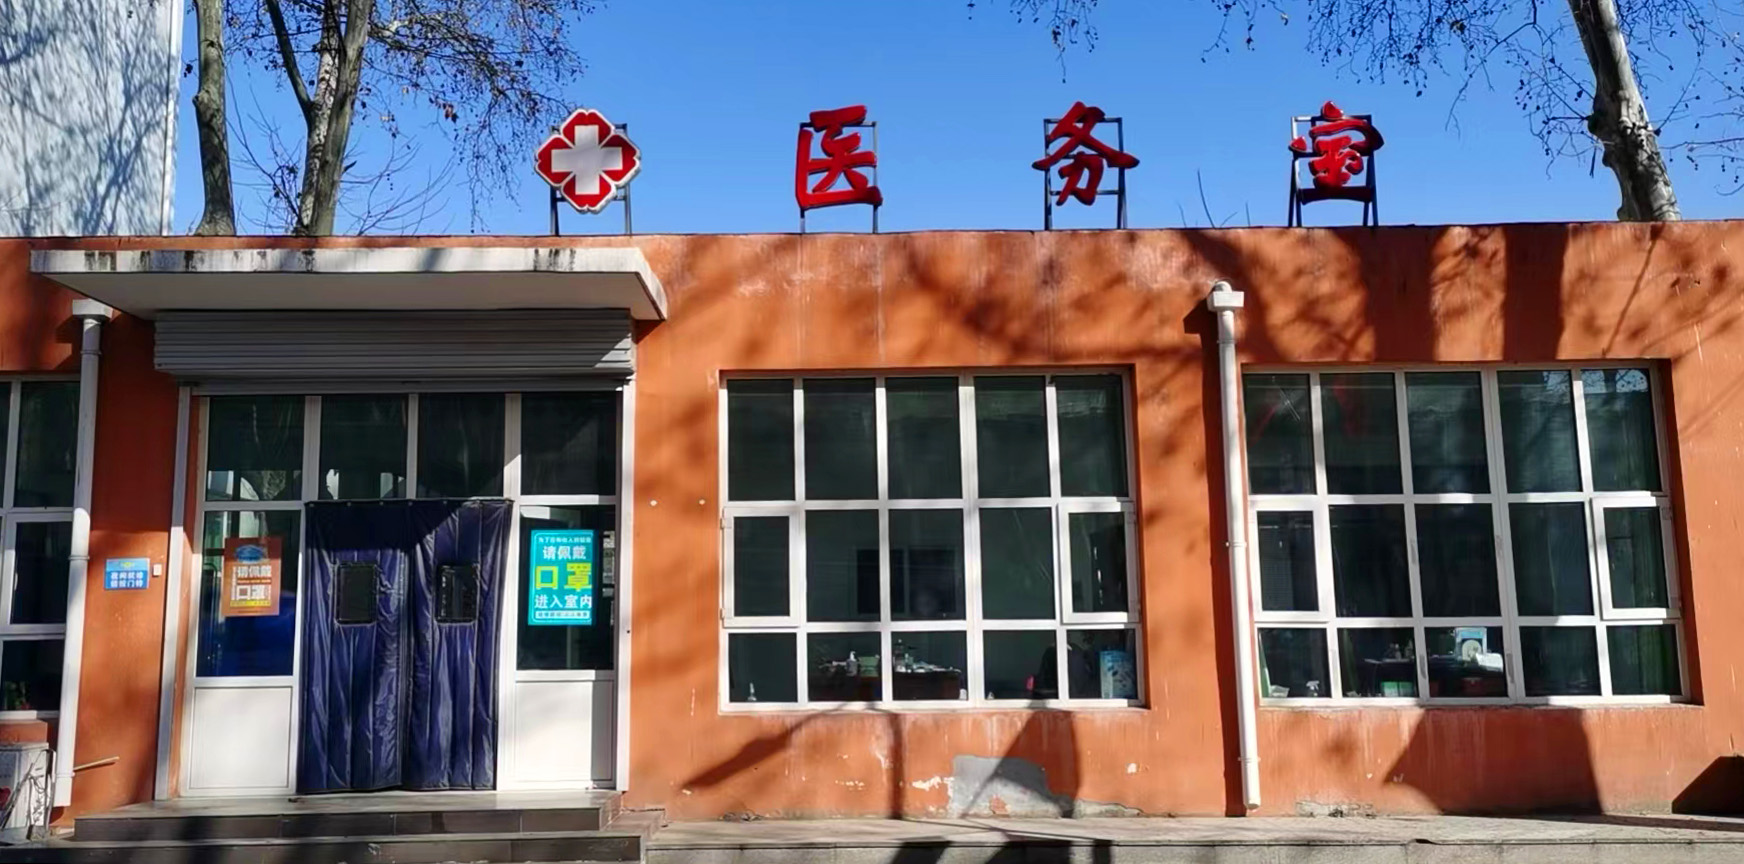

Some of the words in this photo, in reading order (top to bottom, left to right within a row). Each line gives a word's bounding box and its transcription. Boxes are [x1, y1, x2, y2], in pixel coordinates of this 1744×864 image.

[796, 101, 1384, 207] 医务室
[543, 545, 586, 560] 请佩戴
[237, 565, 272, 578] 请佩戴
[535, 562, 592, 592] 口罩
[236, 585, 266, 601] 口罩
[534, 594, 592, 609] 进入室内
